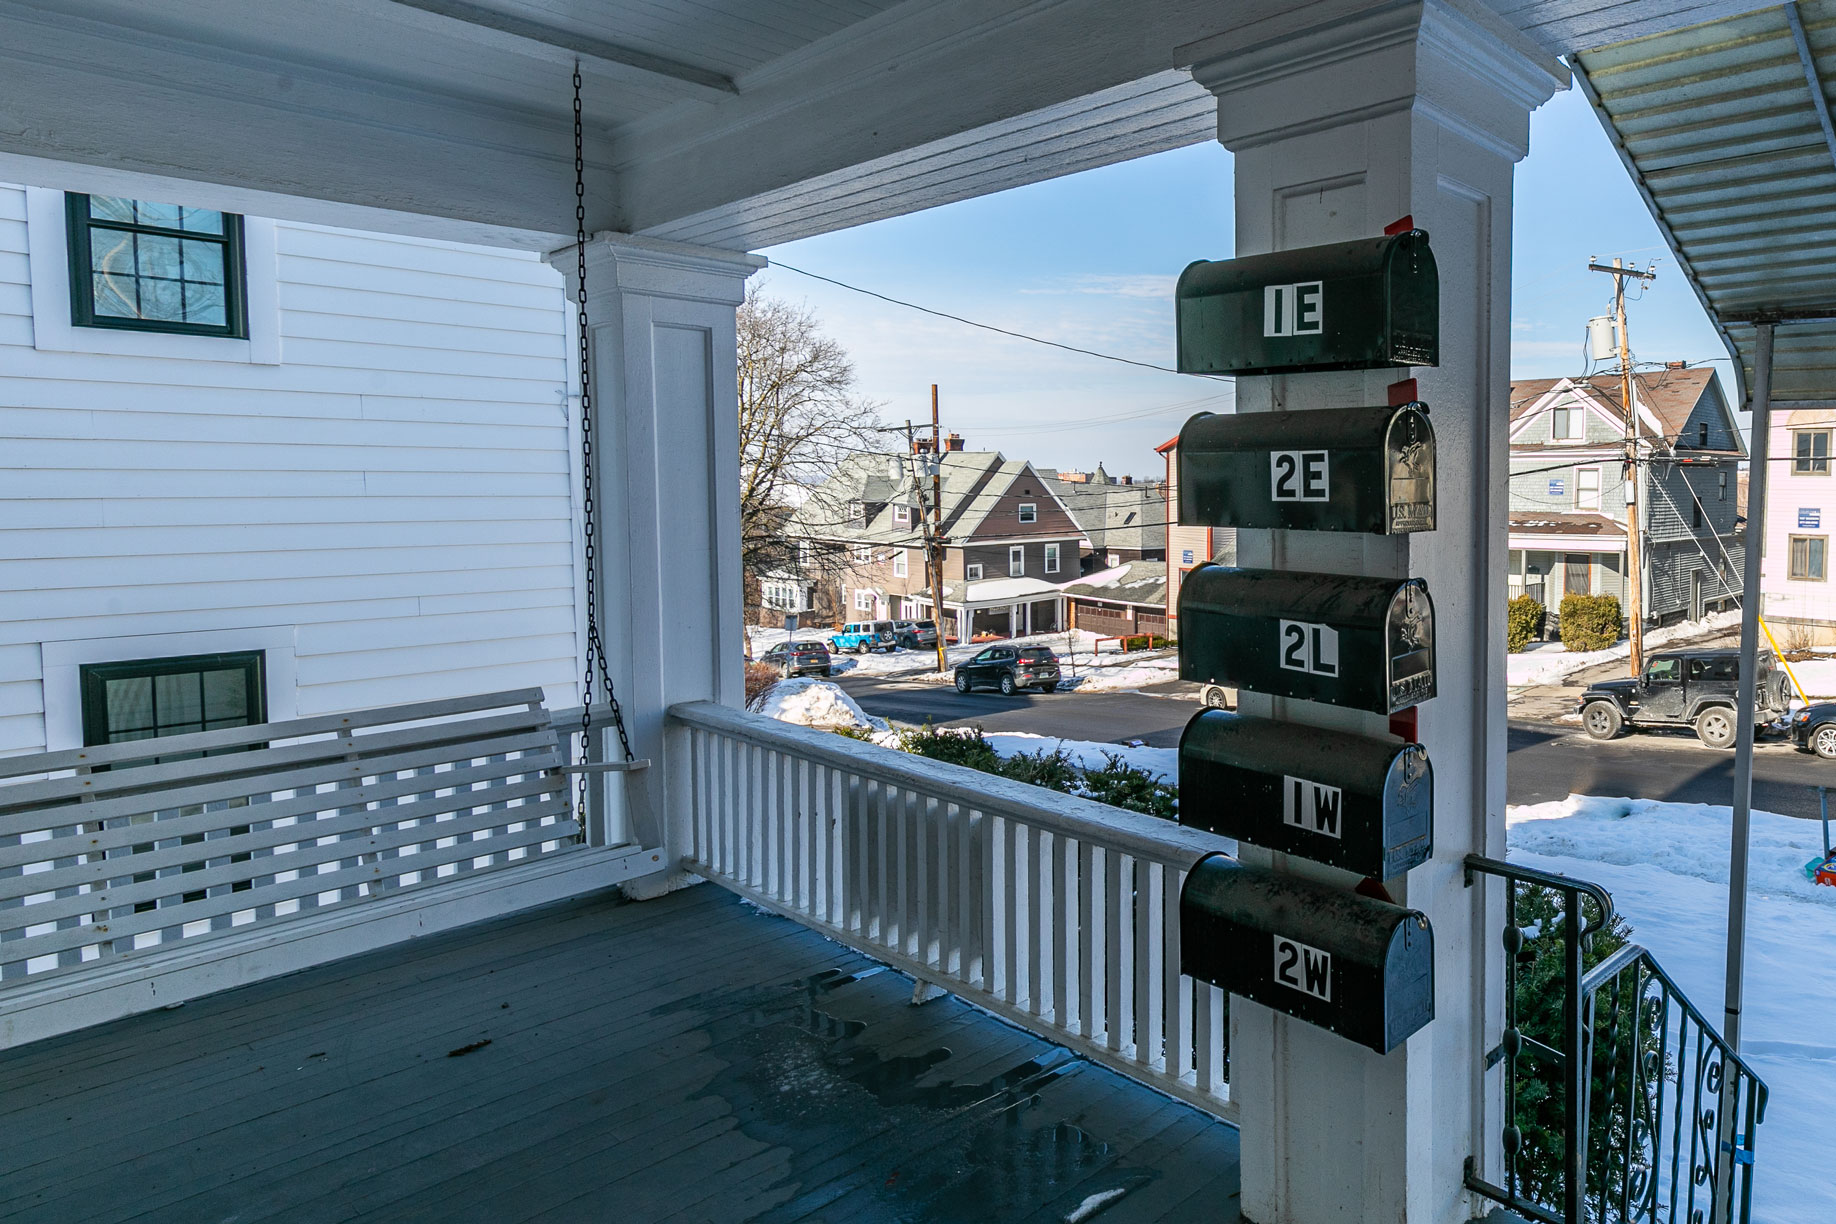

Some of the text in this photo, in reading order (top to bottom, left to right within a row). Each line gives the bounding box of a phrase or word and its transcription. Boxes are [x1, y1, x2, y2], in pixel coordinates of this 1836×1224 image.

[1275, 284, 1320, 334] 1E
[1275, 453, 1326, 498] 2E
[1285, 624, 1336, 675] 2L
[1294, 781, 1340, 834] 1W
[1279, 941, 1329, 998] 2W
